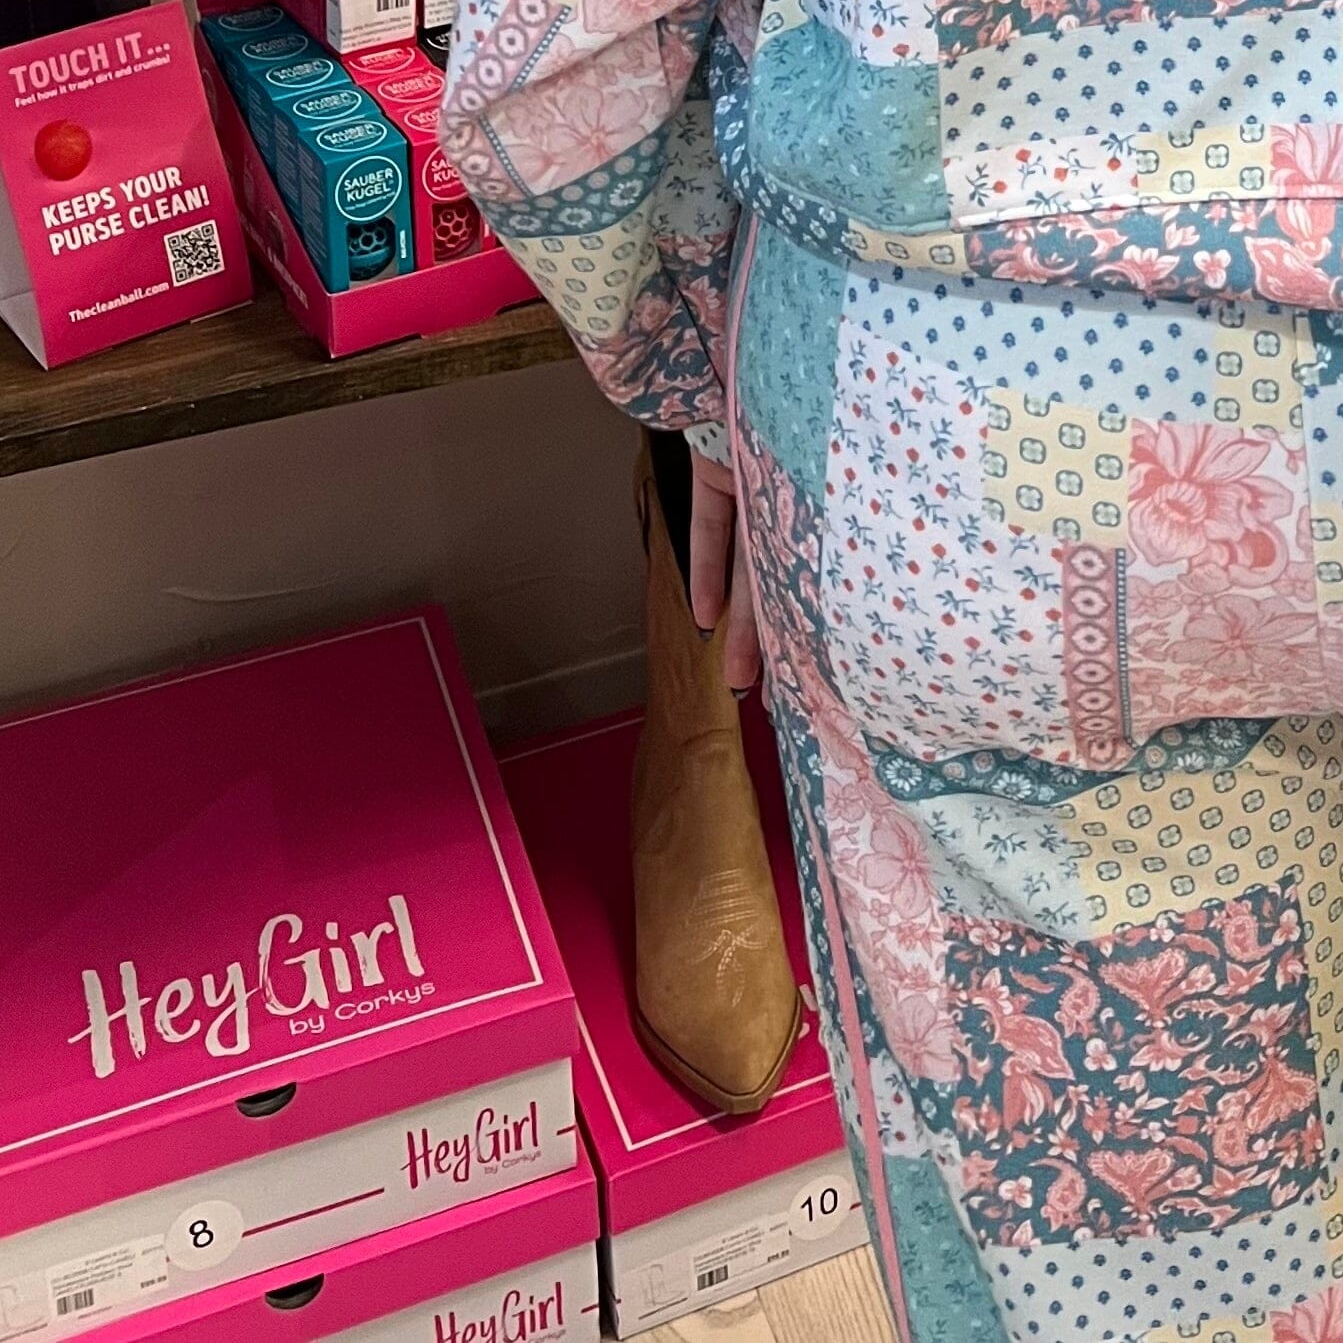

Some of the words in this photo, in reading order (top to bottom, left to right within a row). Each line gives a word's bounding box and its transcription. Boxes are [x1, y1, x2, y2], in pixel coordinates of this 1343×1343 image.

[8, 42, 110, 94] TOUCH
[14, 96, 37, 108] Feel
[37, 89, 59, 102] how
[60, 84, 68, 95] it
[68, 78, 95, 93] traps
[95, 71, 113, 84] dirt
[115, 65, 133, 78] and
[41, 186, 117, 229] KEEPS
[119, 166, 182, 202] YOUR
[344, 167, 394, 191] SAUBER
[346, 181, 392, 203] KUGEL
[48, 212, 125, 256] PURSE
[128, 184, 210, 229] CLEAN!
[68, 281, 170, 323] Thecleanball.com
[289, 1014, 326, 1036] by
[334, 981, 436, 1021] Corkys
[502, 1150, 542, 1169] Corkys
[800, 1187, 839, 1222] 10
[188, 1219, 214, 1248] 8
